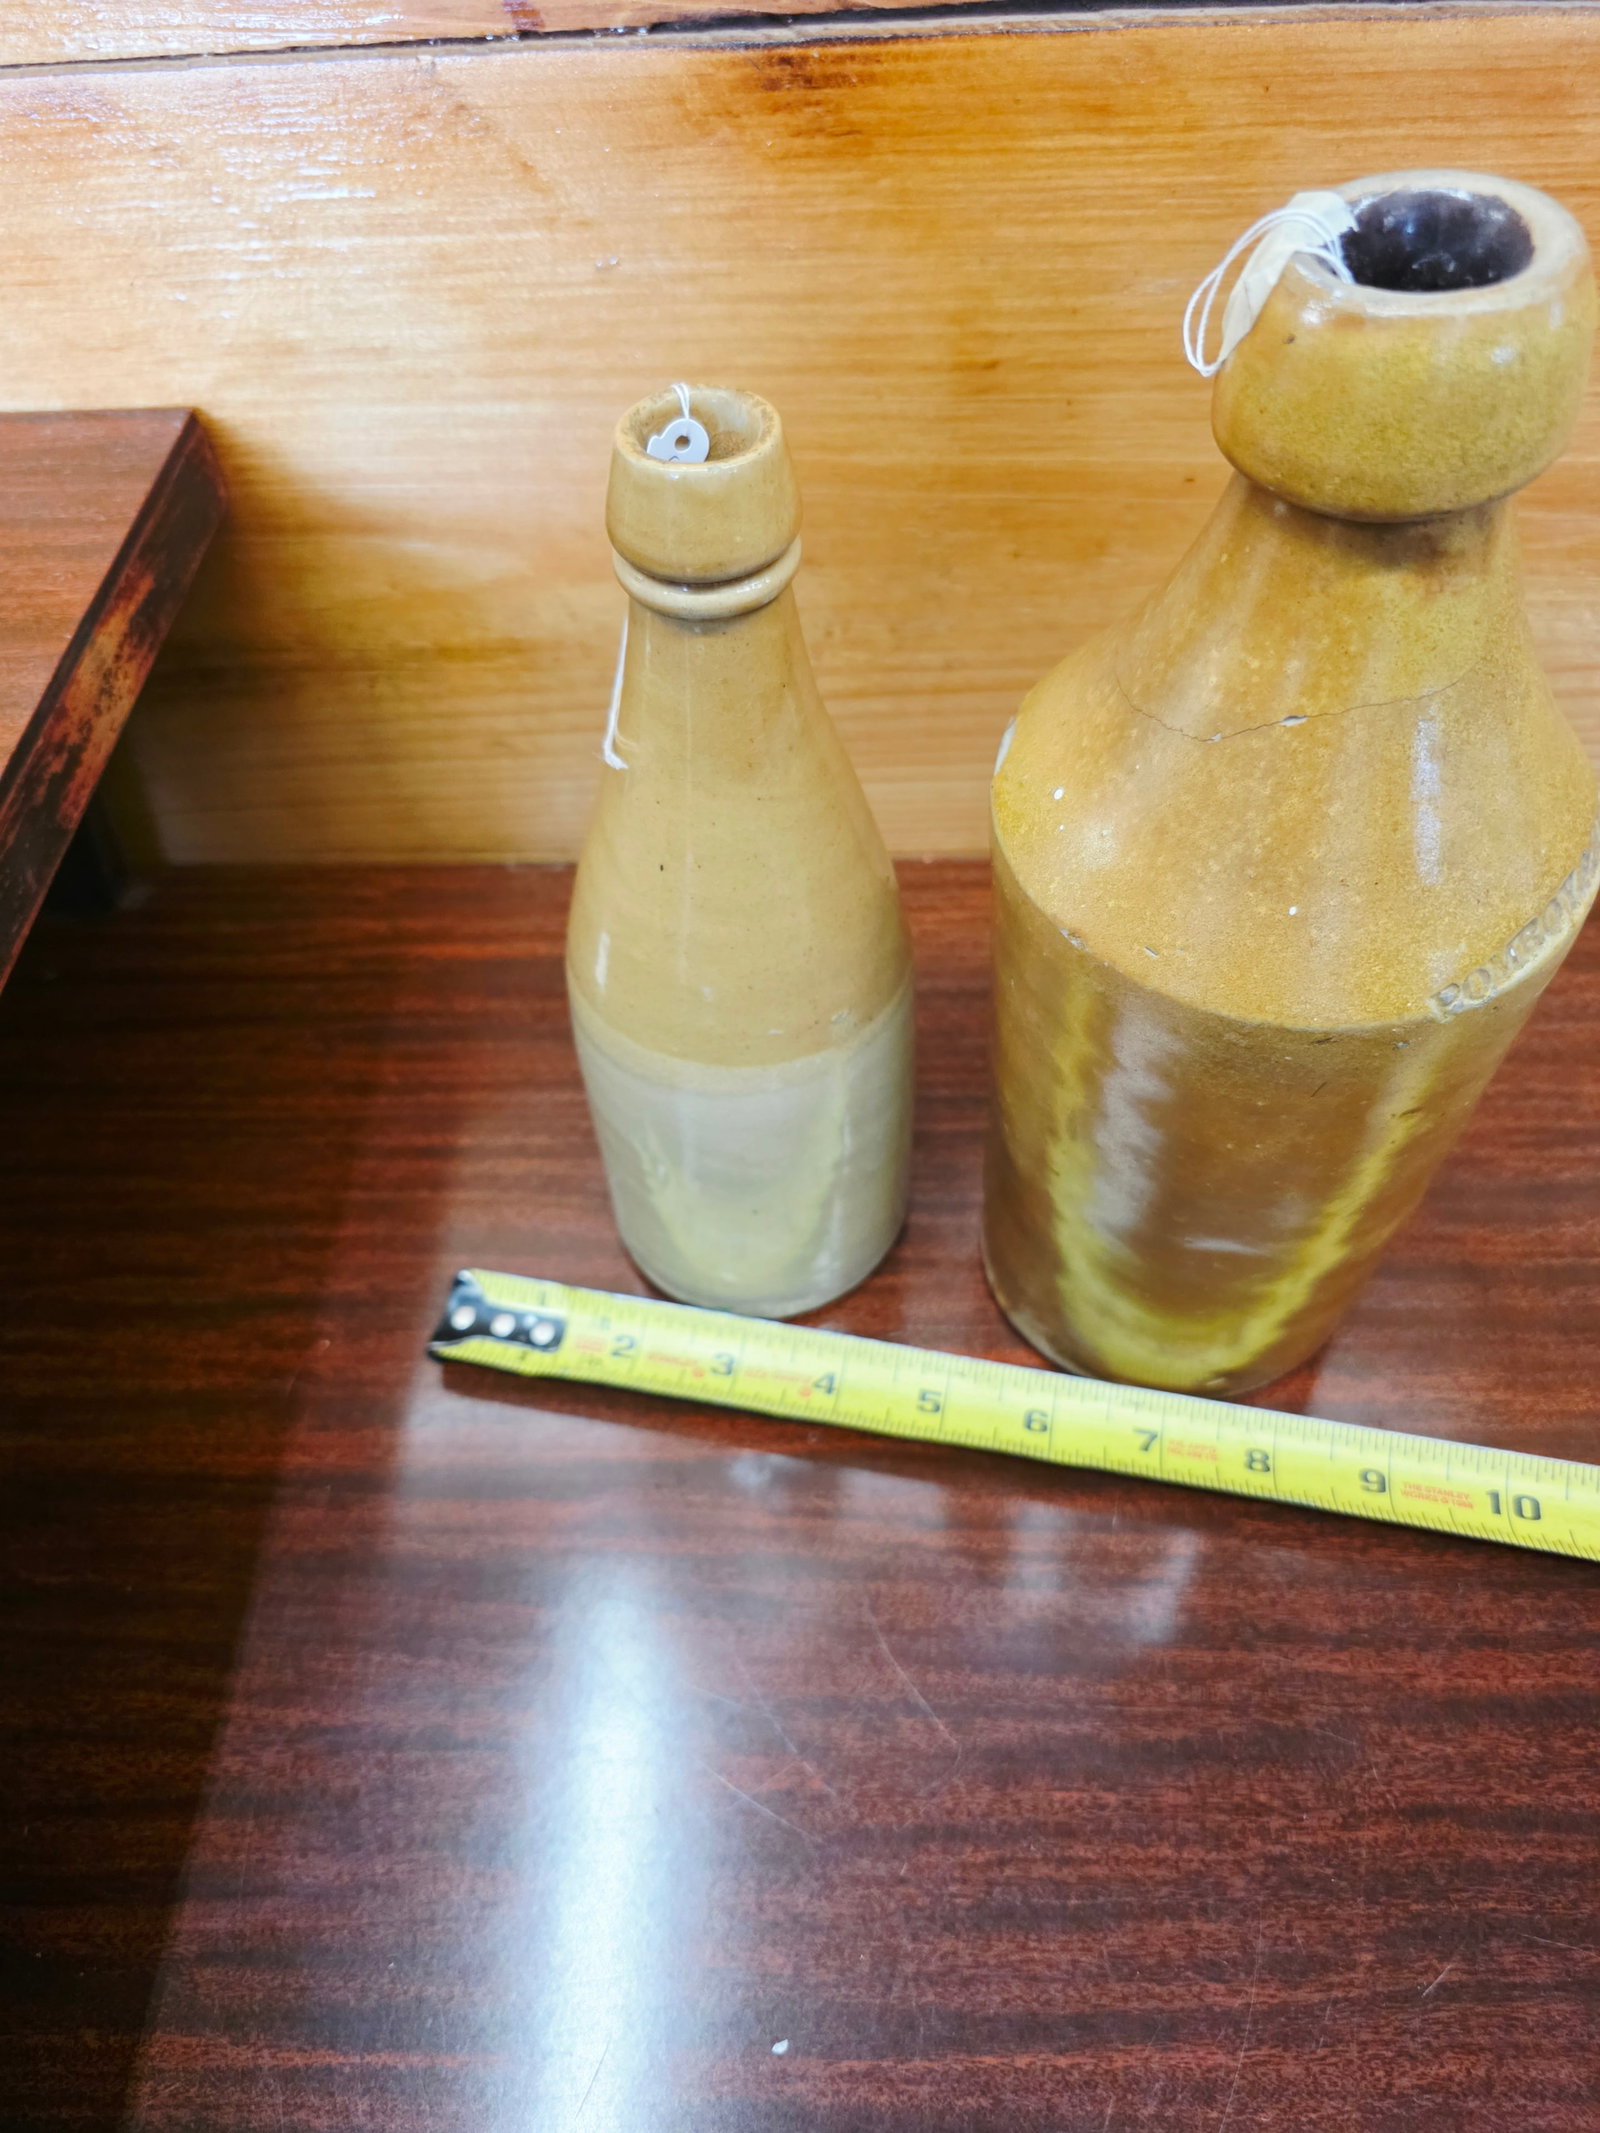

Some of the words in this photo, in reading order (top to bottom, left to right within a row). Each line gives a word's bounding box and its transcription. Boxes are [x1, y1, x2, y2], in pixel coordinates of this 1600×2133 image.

[611, 1336, 636, 1358] 2
[710, 1353, 735, 1376] 3
[812, 1372, 837, 1395] 4
[917, 1389, 942, 1414] 5
[1023, 1409, 1049, 1433] 6
[1132, 1429, 1158, 1452] 7
[1244, 1448, 1271, 1473] 8
[1359, 1469, 1387, 1493] 9
[1486, 1489, 1542, 1521] 10
